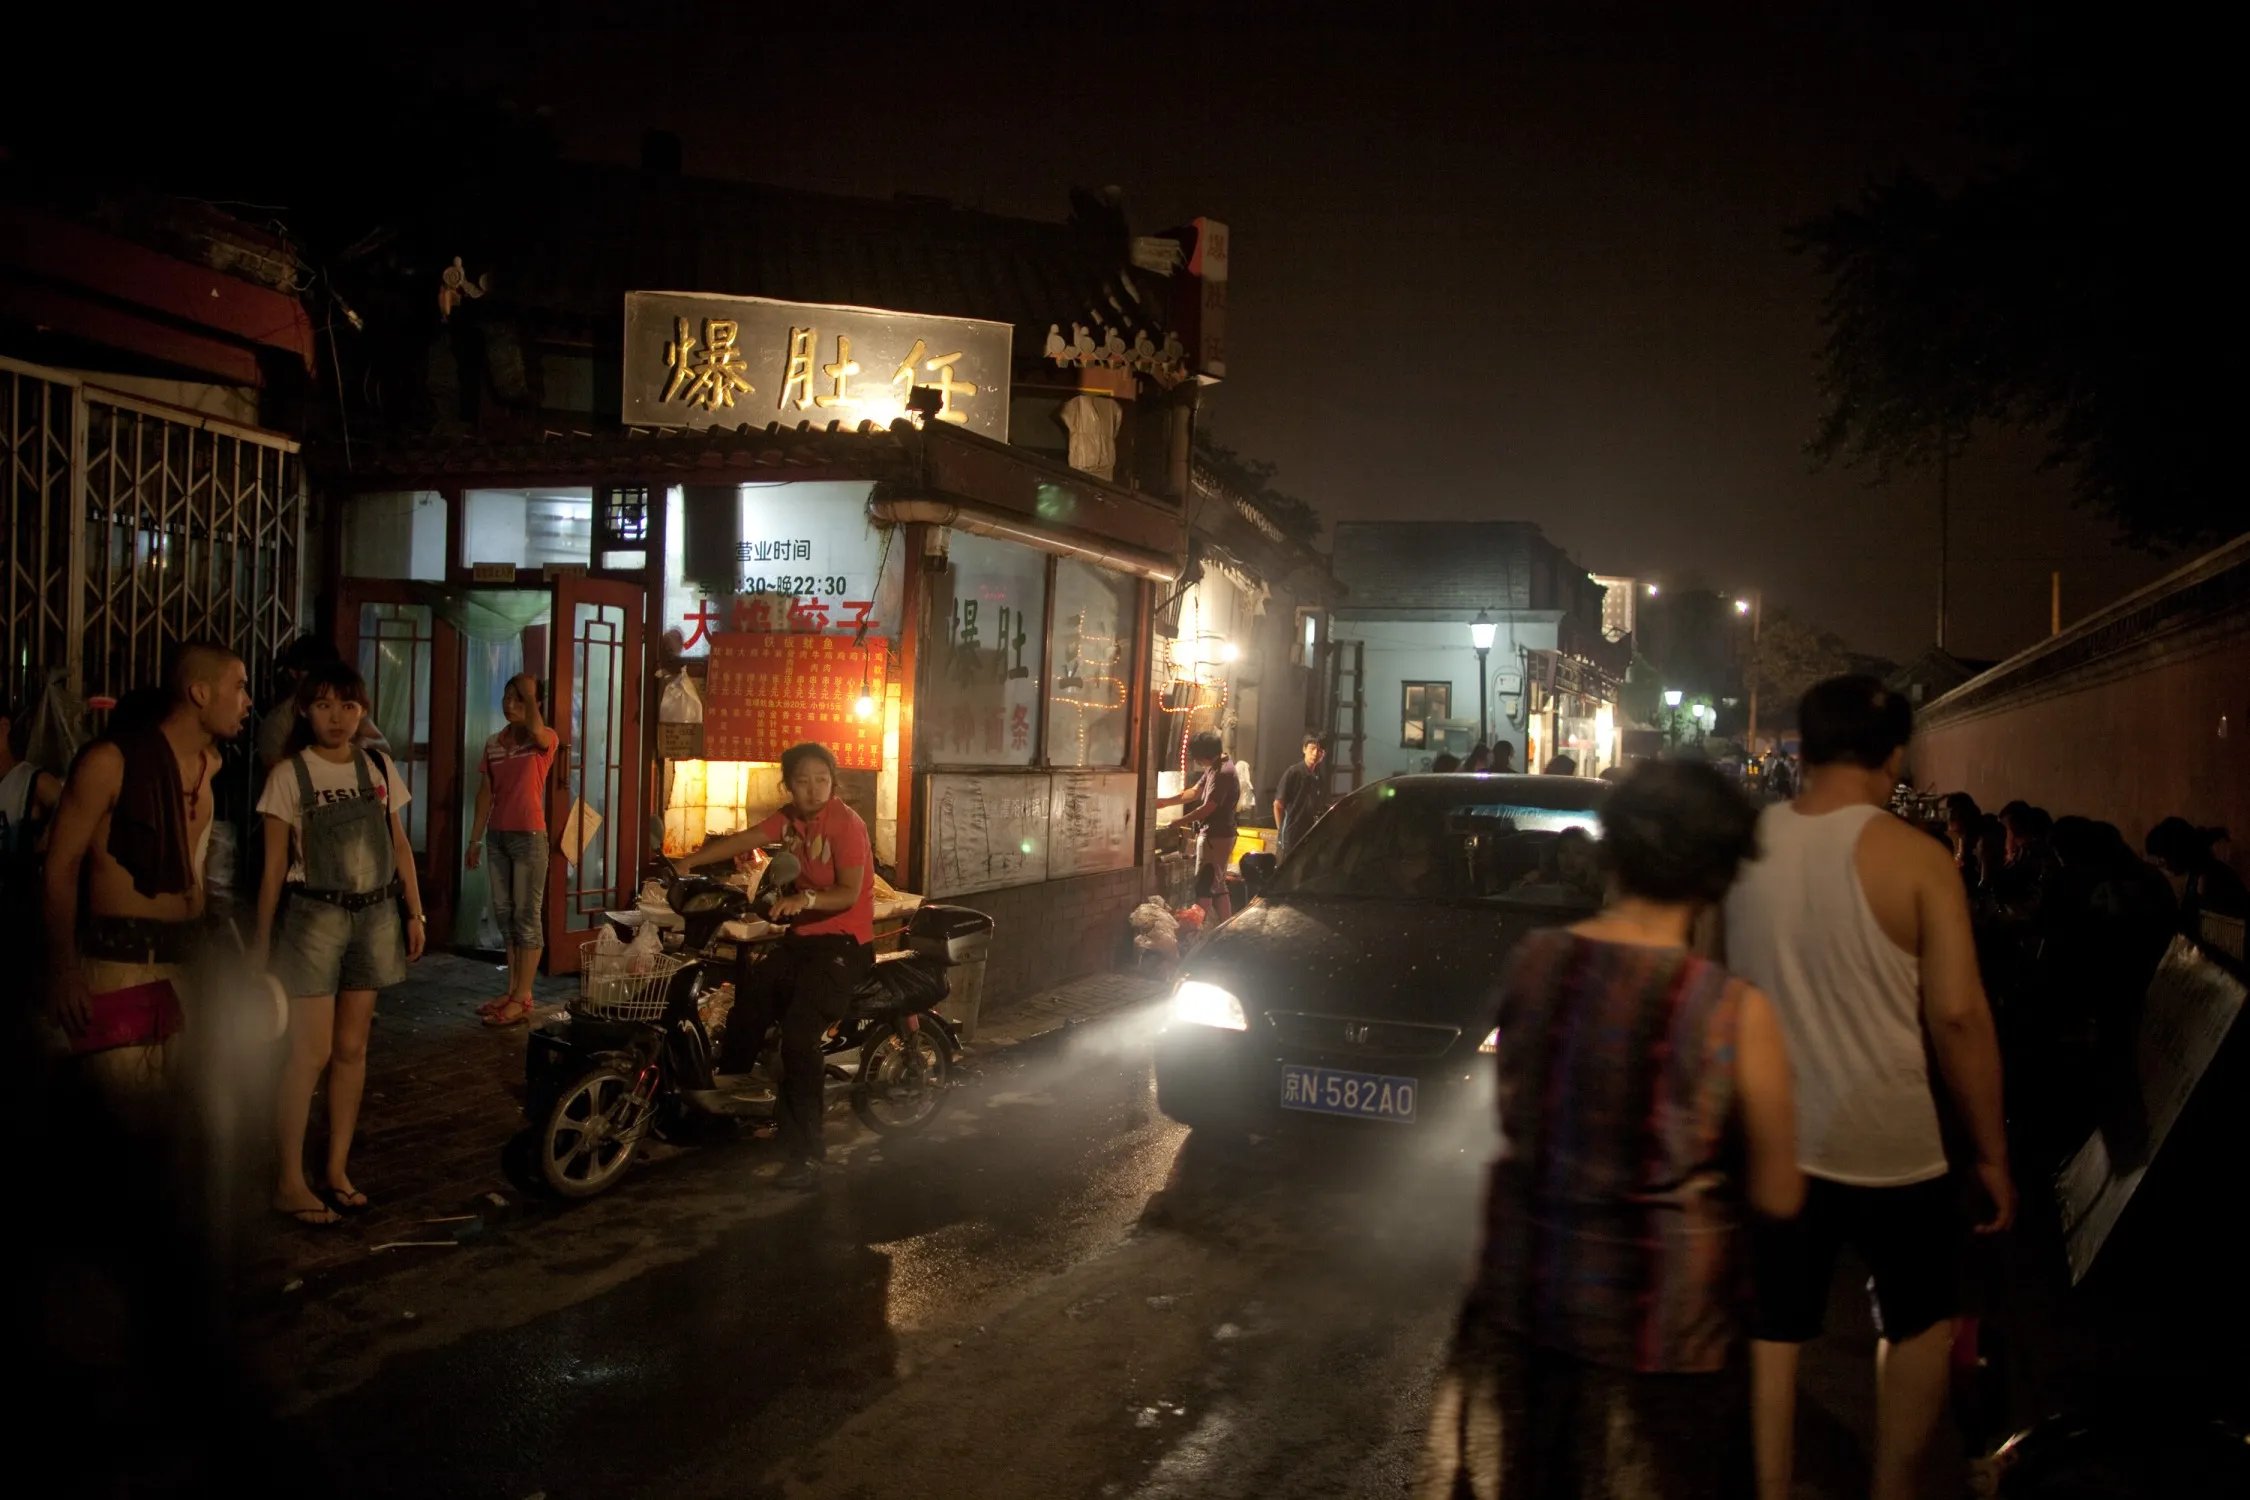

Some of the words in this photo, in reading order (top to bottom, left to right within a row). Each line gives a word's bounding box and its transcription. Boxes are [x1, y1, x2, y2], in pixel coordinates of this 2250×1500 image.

[660, 315, 979, 425] 爆肚任
[736, 539, 811, 562] 营业时间
